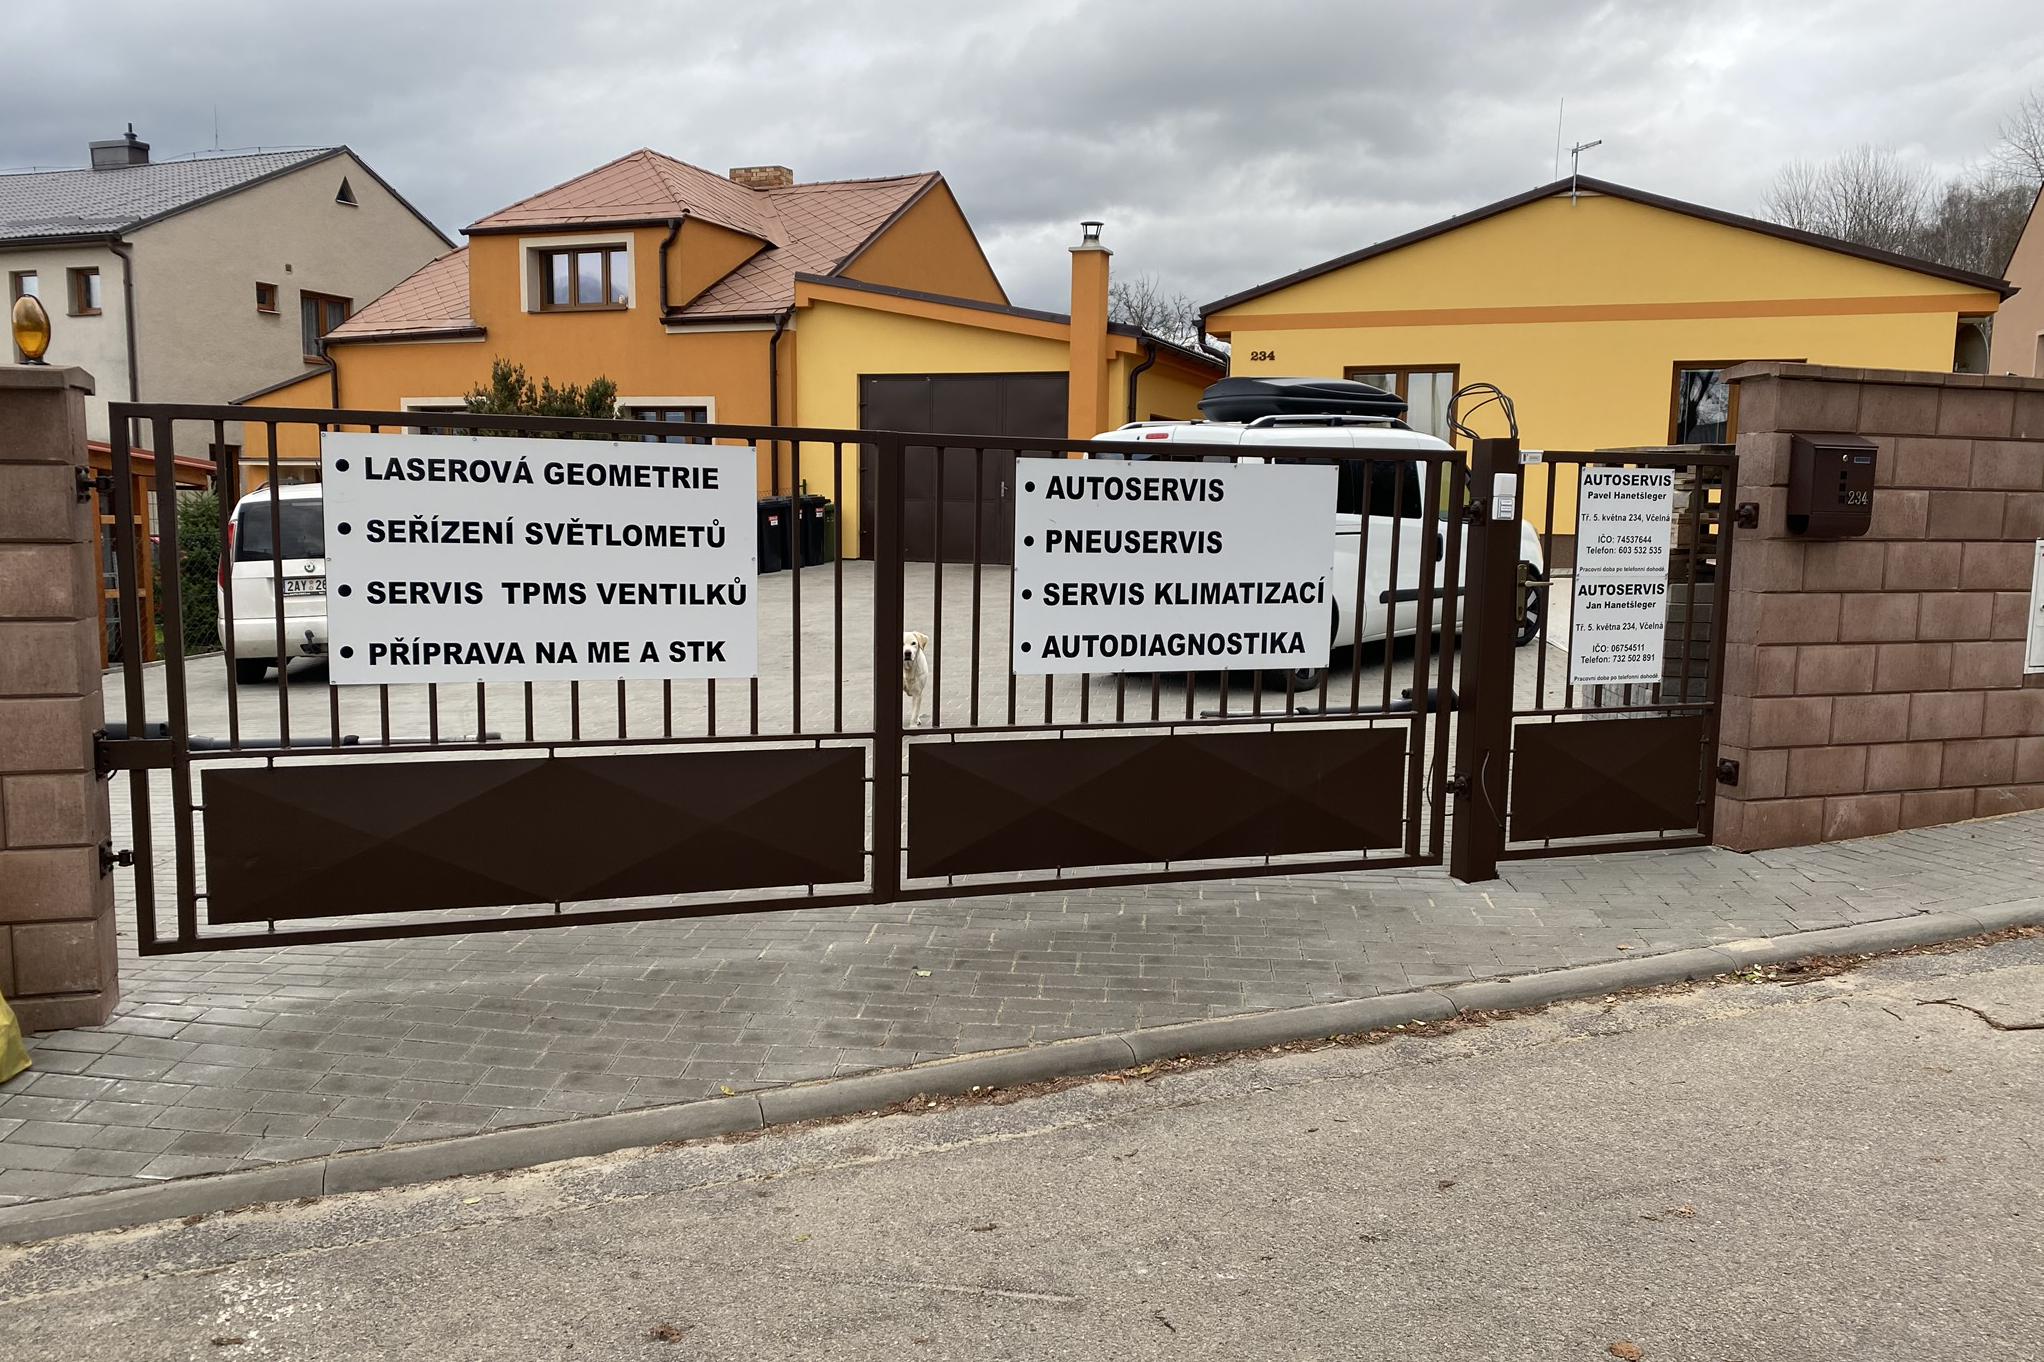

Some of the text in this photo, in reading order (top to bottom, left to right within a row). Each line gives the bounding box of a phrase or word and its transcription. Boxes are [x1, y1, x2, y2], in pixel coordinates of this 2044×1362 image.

[1250, 350, 1275, 361] 234
[364, 456, 719, 490] LASEROVÁ GEOMETRIE
[1584, 474, 1672, 486] AUTOSERVIS
[1045, 476, 1224, 502] AUTOSERVIS
[1588, 492, 1667, 501] Pavel Hanetšleger
[1848, 490, 1868, 505] 234
[1629, 514, 1644, 522] 234,
[1646, 513, 1670, 521] Včelná
[366, 514, 726, 548] SEŘÍZENÍ SVĚTLOMETŮ
[1045, 530, 1223, 554] PNEUSERVIS
[1598, 534, 1614, 543] IČO:
[1586, 546, 1662, 554] Telefon: 603 532 535
[287, 580, 306, 592] 2AY
[366, 576, 747, 606] SERVIS TPMS VENTILKŮ
[1043, 576, 1325, 606] SERVIS KLIMATIZACÍ
[1578, 583, 1665, 596] AUTOSERVIS
[1604, 601, 1656, 610] Hanetšleger
[1596, 623, 1620, 631] května
[1622, 623, 1637, 631] 234,
[1640, 622, 1664, 630] Včelná
[368, 636, 726, 666] PŘÍPRAVA NA ME A STK
[1041, 632, 1306, 659] AUTODIAGNOSTIKA
[1592, 643, 1645, 652] IČO: 06754511
[1581, 654, 1655, 664] Telefon: 732 502 891
